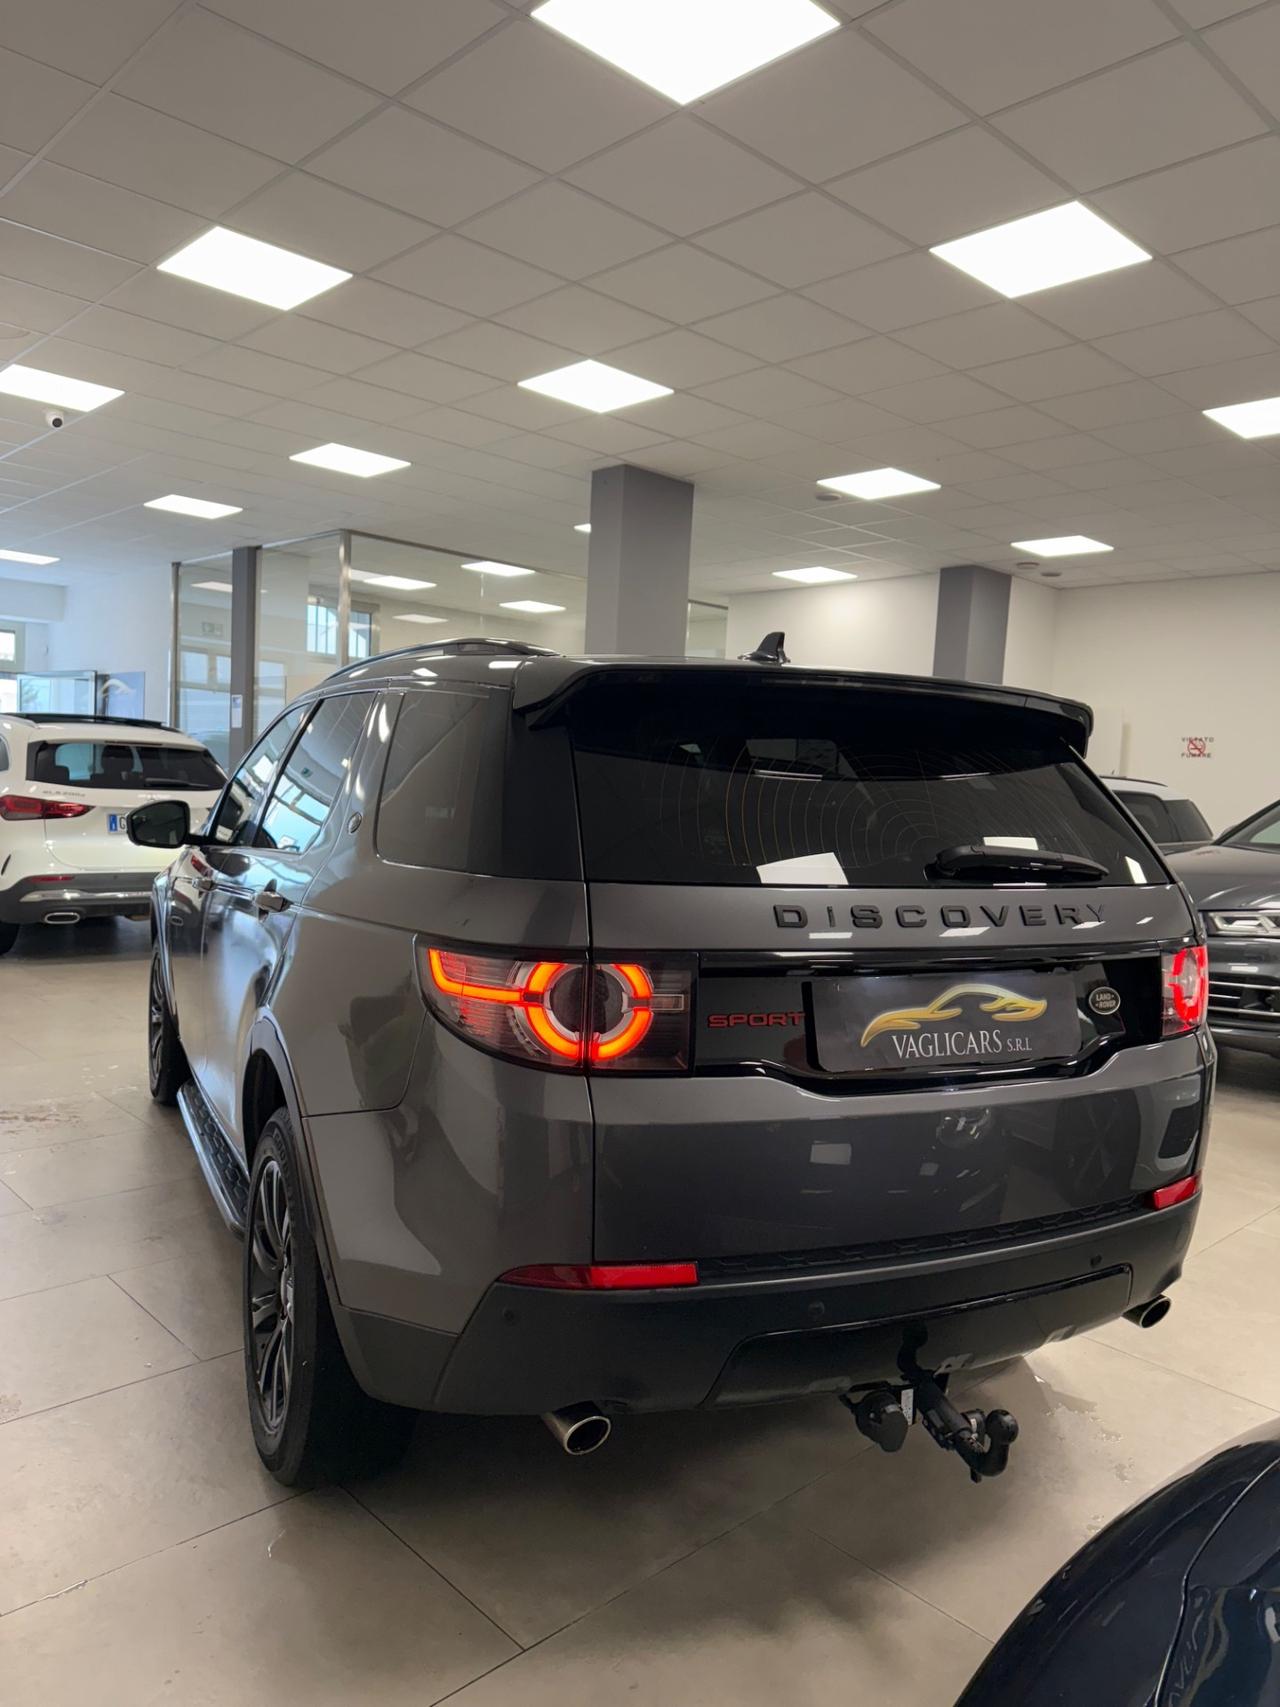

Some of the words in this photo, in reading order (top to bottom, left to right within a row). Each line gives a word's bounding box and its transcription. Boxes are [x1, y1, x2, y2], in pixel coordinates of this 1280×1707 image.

[773, 903, 1105, 929] DISCOVERY
[708, 1011, 806, 1028] SPORT
[891, 1029, 1003, 1059] VAGLICARS
